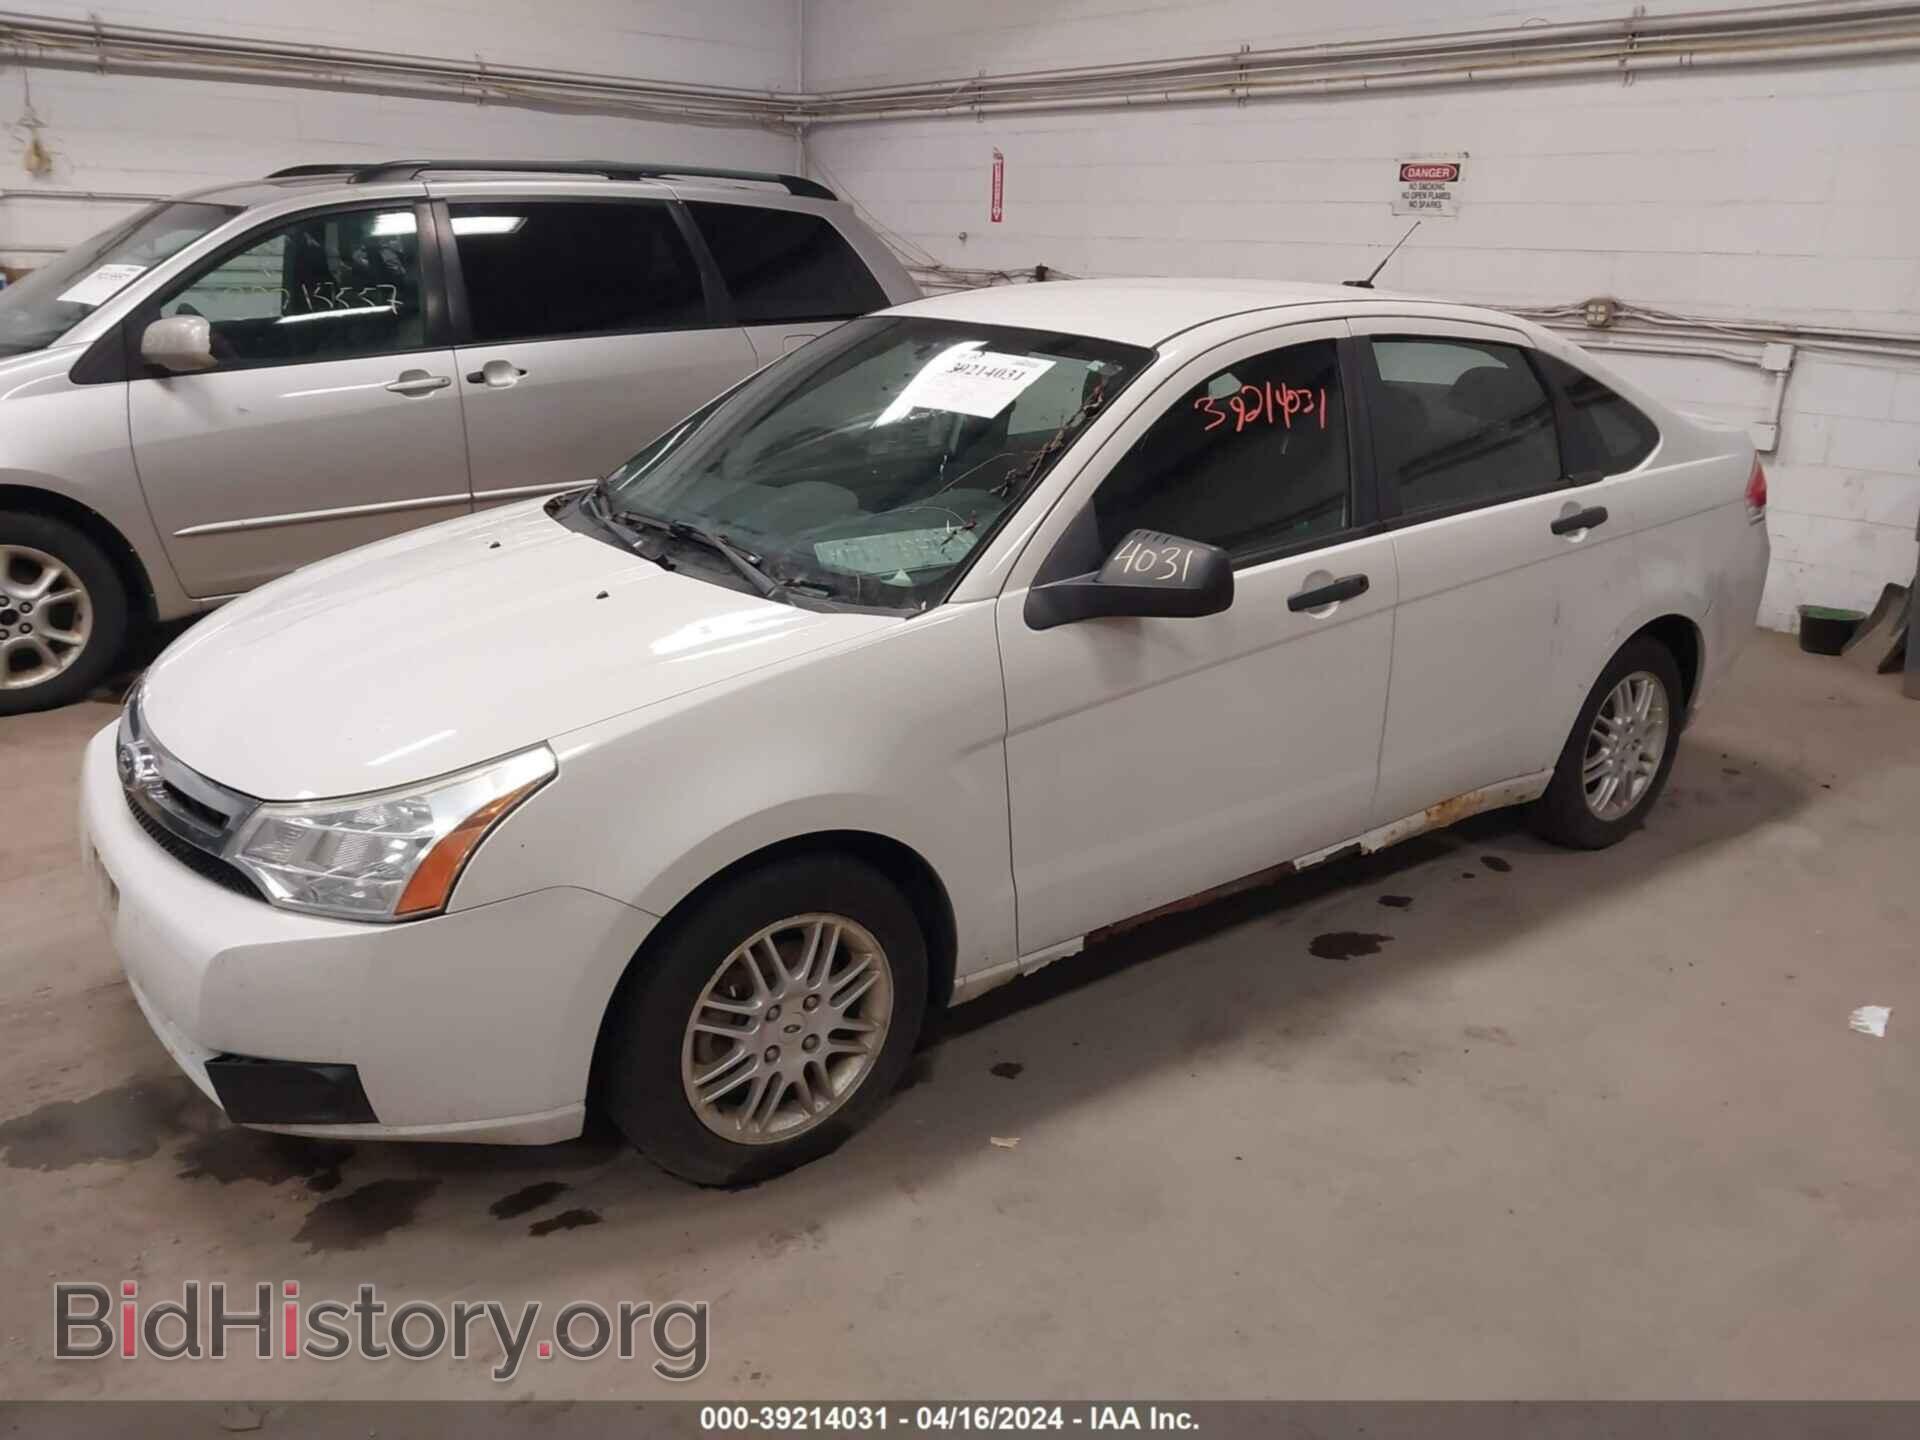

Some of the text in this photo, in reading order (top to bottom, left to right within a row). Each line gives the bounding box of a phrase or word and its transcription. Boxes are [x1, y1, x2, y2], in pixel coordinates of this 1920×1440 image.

[1407, 167, 1450, 178] DANGER
[1194, 381, 1326, 432] 39214031
[1114, 540, 1193, 582] 4031
